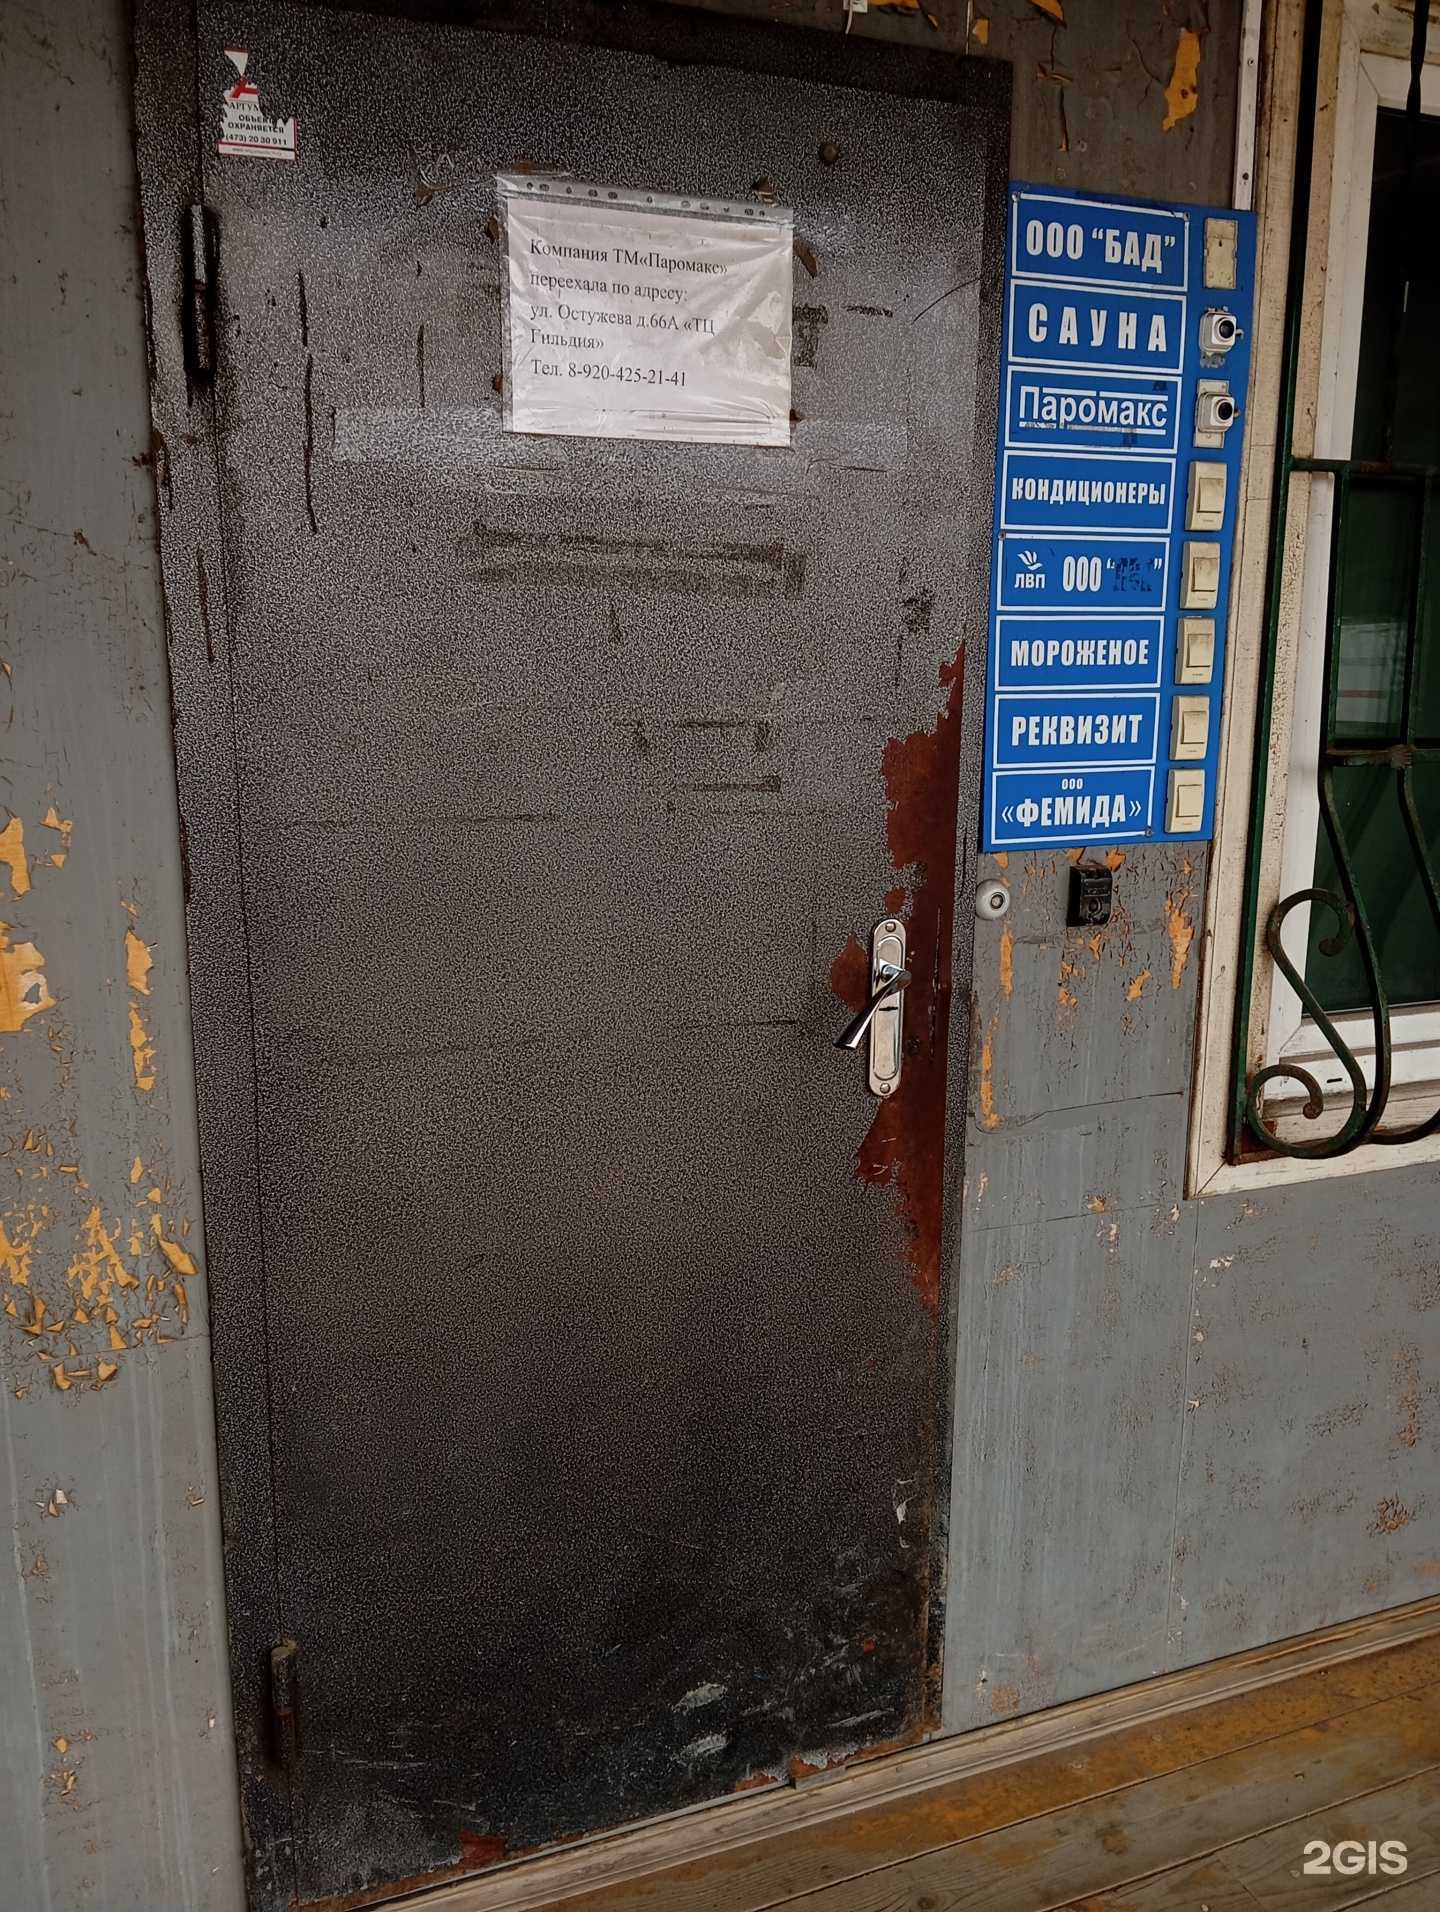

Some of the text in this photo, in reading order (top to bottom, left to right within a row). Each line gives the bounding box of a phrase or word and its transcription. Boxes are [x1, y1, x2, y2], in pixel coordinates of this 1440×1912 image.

[225, 133, 247, 142] (473)
[227, 122, 284, 134] ОХРАНЯЕТСЯ
[1026, 219, 1084, 260] ООО
[529, 238, 728, 276] Компания ТМ«Паромакс»
[530, 272, 688, 301] переехала по адресу:
[530, 303, 715, 336] ул. Остужева д.66А «ТЦ
[1028, 303, 1167, 352] САУНА
[530, 328, 604, 349] Гильдия»
[531, 359, 686, 387] Тел. 8-920-425-21-41
[1019, 385, 1168, 430] Паромакс
[1011, 478, 1166, 505] КОНДИЦИОНЕРЫ
[1014, 573, 1045, 590] ЛВП
[1062, 556, 1101, 592] ООО
[1010, 639, 1149, 667] МОРОЖЕНОЕ
[1011, 714, 1143, 747] РЕКВИЗИТ
[1061, 778, 1083, 790] ООО
[1002, 794, 1141, 828] «ФЕМИДА»
